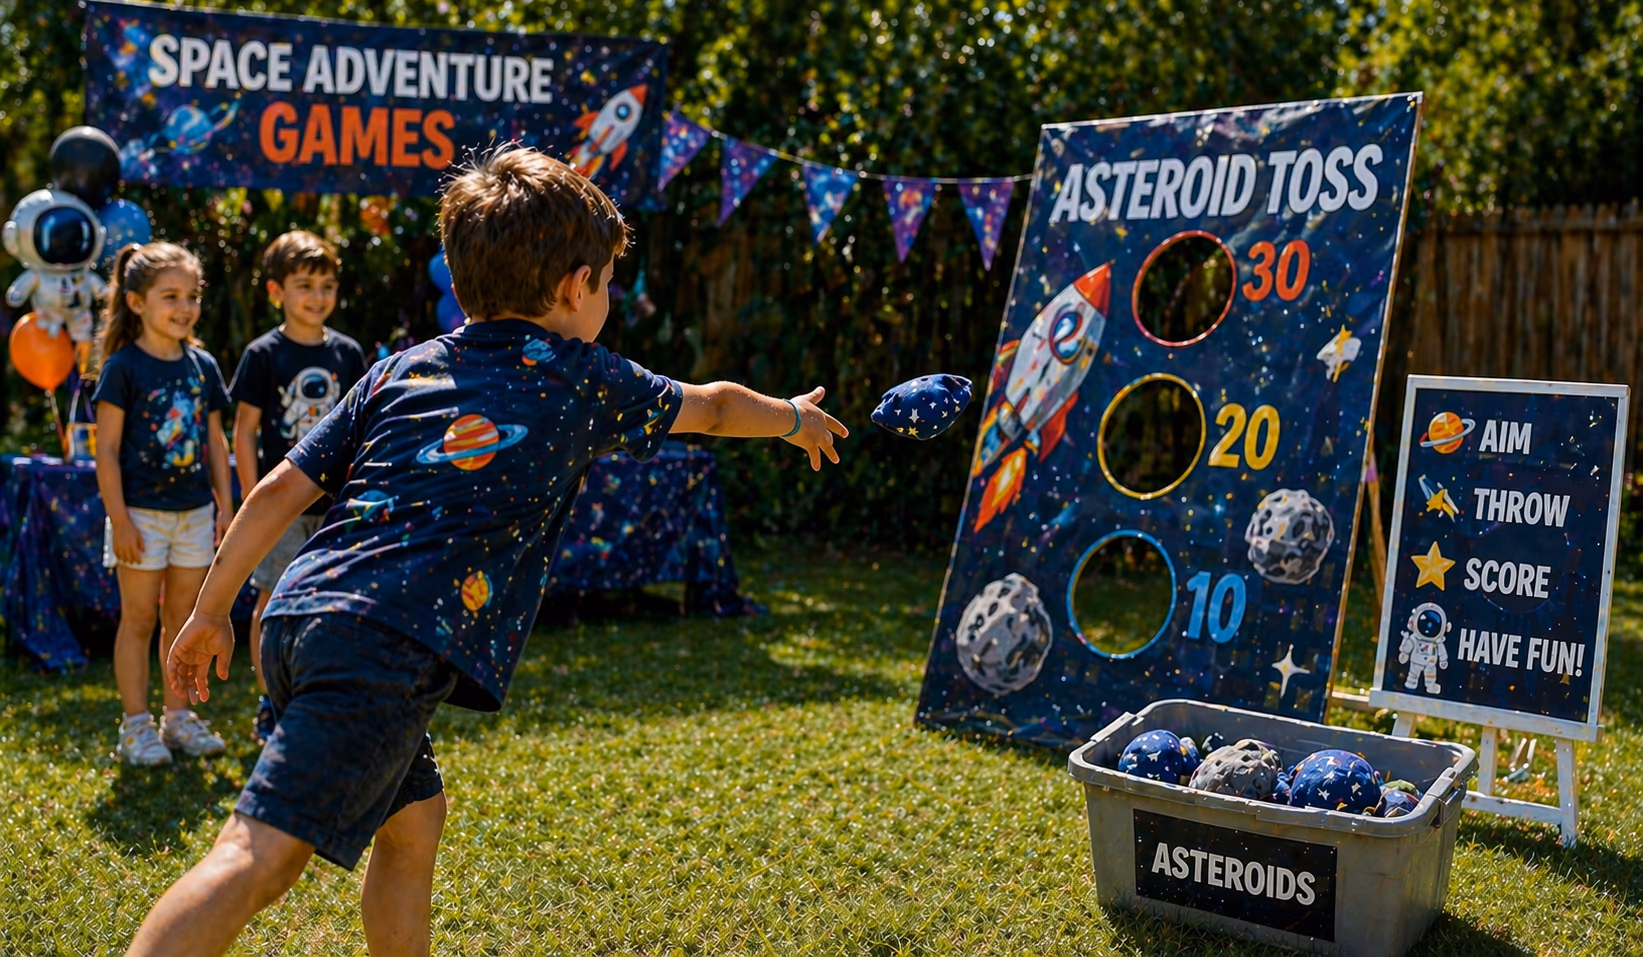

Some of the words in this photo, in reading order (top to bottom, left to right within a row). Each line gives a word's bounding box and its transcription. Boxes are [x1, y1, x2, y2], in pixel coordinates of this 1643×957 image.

[148, 34, 293, 92] SPACE
[303, 45, 554, 103] ADVENTURE
[259, 102, 456, 170] GAMES
[1049, 153, 1257, 223] ASTEROID
[1267, 144, 1383, 214] TOSS
[1242, 239, 1311, 301] 30
[1208, 403, 1280, 470] 20
[1478, 419, 1532, 455] AIM
[1473, 487, 1570, 527] THROW
[1186, 571, 1246, 644] 10
[1463, 557, 1551, 599] SCORE
[1457, 628, 1522, 668] HAVE
[1526, 637, 1586, 677] FUN!
[1151, 842, 1316, 906] ASTEROIDS
